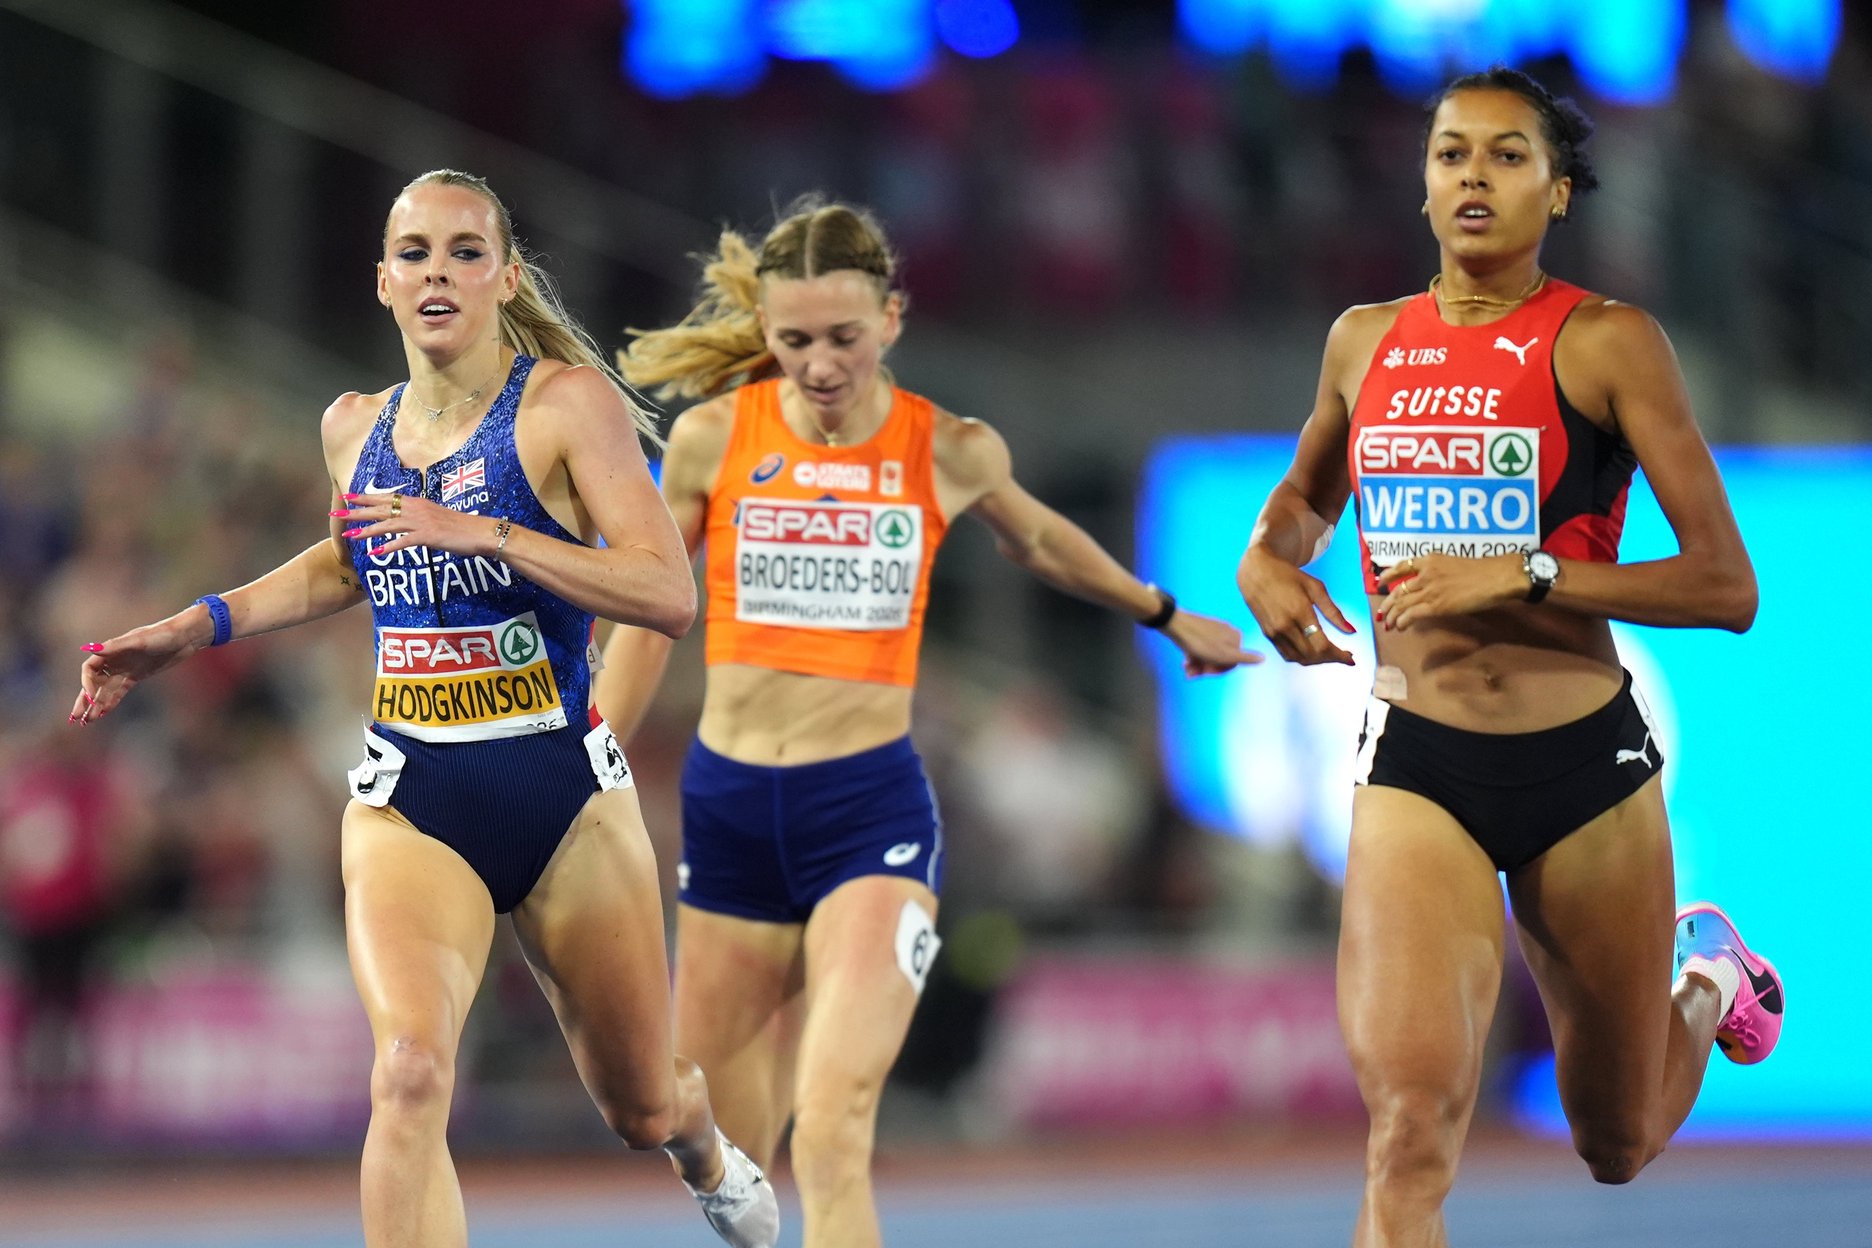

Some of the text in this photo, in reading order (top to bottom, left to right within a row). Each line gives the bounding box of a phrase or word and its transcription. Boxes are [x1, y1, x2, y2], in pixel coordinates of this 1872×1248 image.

[1407, 347, 1448, 366] UBS
[1362, 436, 1481, 470] SPAR
[746, 507, 868, 542] SPAR
[1362, 485, 1530, 530] WERRO
[366, 556, 512, 608] BRITAIN
[384, 636, 495, 669] SPAR
[377, 667, 554, 723] HODGKINSON
